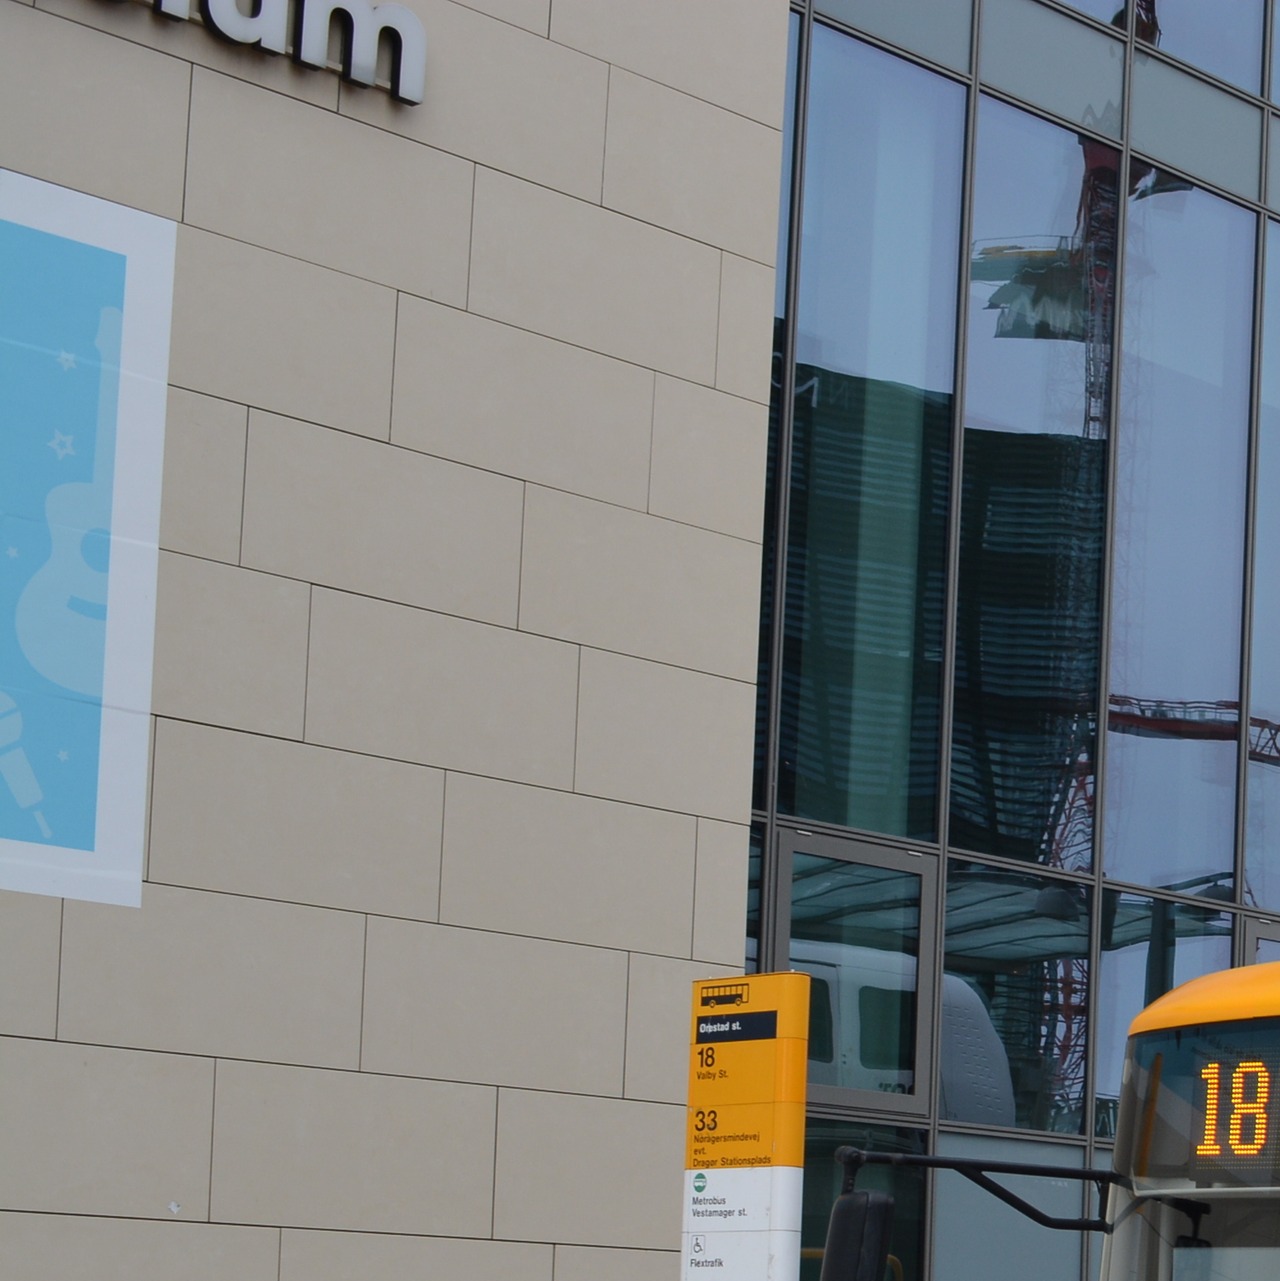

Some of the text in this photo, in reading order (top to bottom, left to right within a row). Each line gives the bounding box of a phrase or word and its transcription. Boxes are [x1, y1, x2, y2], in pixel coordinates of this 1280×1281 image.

[731, 1021, 742, 1031] st.
[697, 1046, 715, 1068] 18
[697, 1070, 728, 1081] Valby St.
[1196, 1061, 1270, 1156] 18
[694, 1109, 718, 1132] 33
[693, 1147, 707, 1156] evt.
[692, 1155, 771, 1169] Dragør Stationsplads
[692, 1196, 726, 1206] Metrobus
[692, 1208, 735, 1219] Vestamager
[690, 1258, 724, 1268] Flextrafik
